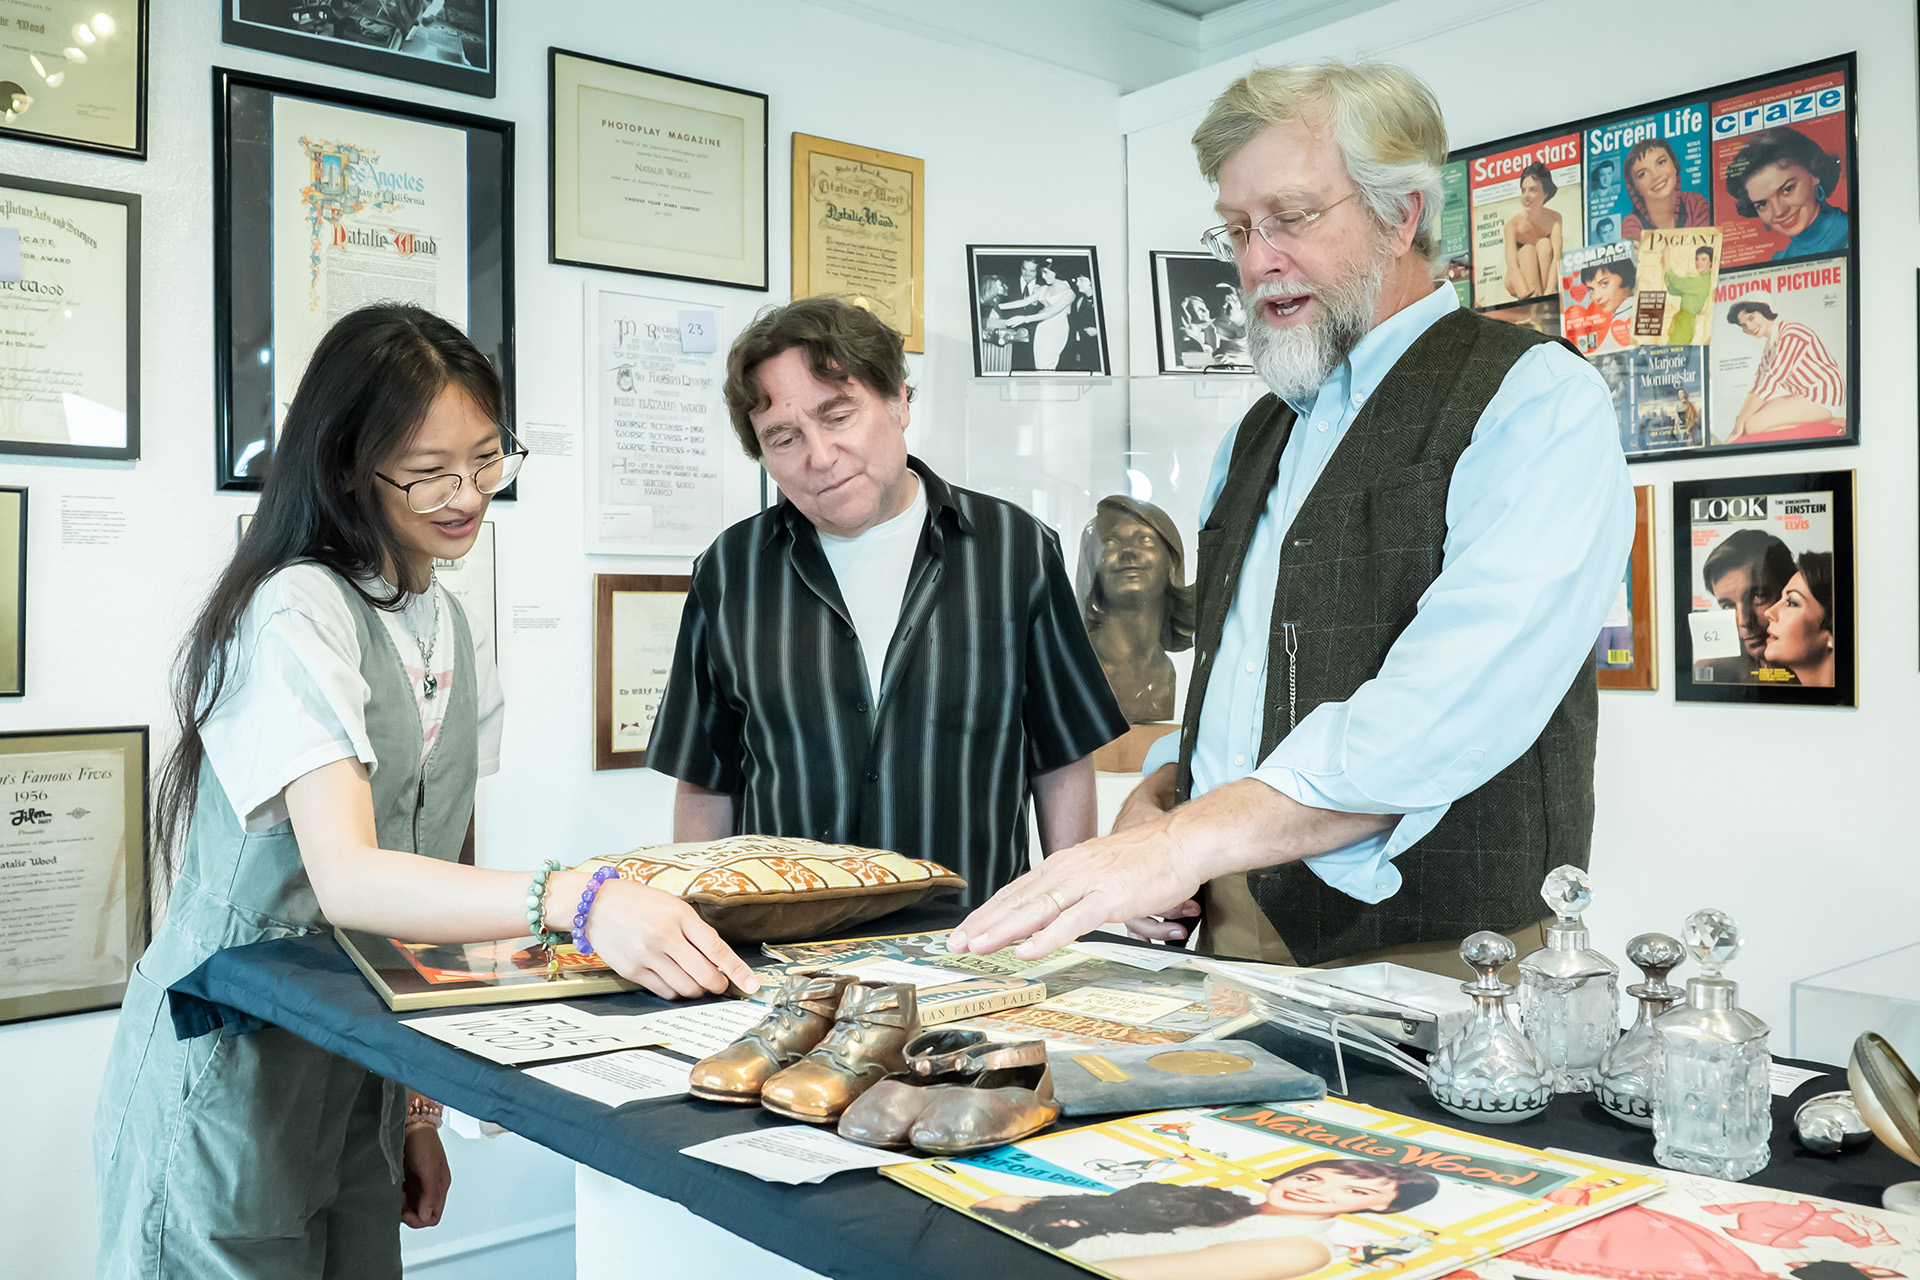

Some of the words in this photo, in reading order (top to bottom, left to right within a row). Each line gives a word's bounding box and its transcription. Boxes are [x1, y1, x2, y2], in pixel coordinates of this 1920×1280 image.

[16, 18, 45, 34] Wood
[1804, 80, 1834, 92] AMERICA
[1715, 89, 1842, 133] craze
[601, 119, 661, 137] PHOTOPLAY
[668, 131, 722, 148] MAGAZINE
[1590, 121, 1657, 155] Screen
[1664, 107, 1703, 138] Life
[1474, 152, 1532, 182] Screen
[1536, 140, 1577, 165] stars
[366, 164, 425, 192] Angeles
[826, 201, 864, 226] Natalie
[329, 222, 389, 251] Natalie
[389, 228, 438, 260] Wood
[1650, 231, 1718, 250] PAGEANT
[40, 255, 71, 264] AWARD
[1563, 240, 1632, 268] COMPACT
[20, 280, 65, 296] Wood
[1714, 277, 1772, 304] MOTION
[1777, 266, 1842, 293] PICTURE
[687, 322, 704, 336] 23
[1649, 353, 1687, 374] Marjorie
[1640, 368, 1697, 389] Morningstar
[680, 402, 708, 414] WOOD
[1693, 497, 1765, 520] LOOK
[1785, 503, 1827, 515] EINSTEIN
[1785, 519, 1810, 530] ELVIS
[1704, 630, 1720, 642] 62
[22, 769, 73, 784] Famous
[78, 766, 114, 781] Fives
[15, 790, 49, 803] 1956
[9, 807, 53, 826] Film
[0, 859, 27, 870] atalie
[30, 855, 58, 867] Wood
[954, 999, 994, 1016] FAIRY
[1001, 990, 1042, 1006] TALES
[1008, 1152, 1032, 1162] 2
[1220, 1109, 1397, 1157] Natalie
[1398, 1145, 1539, 1187] Wood
[1049, 1172, 1102, 1188] DOLLS
